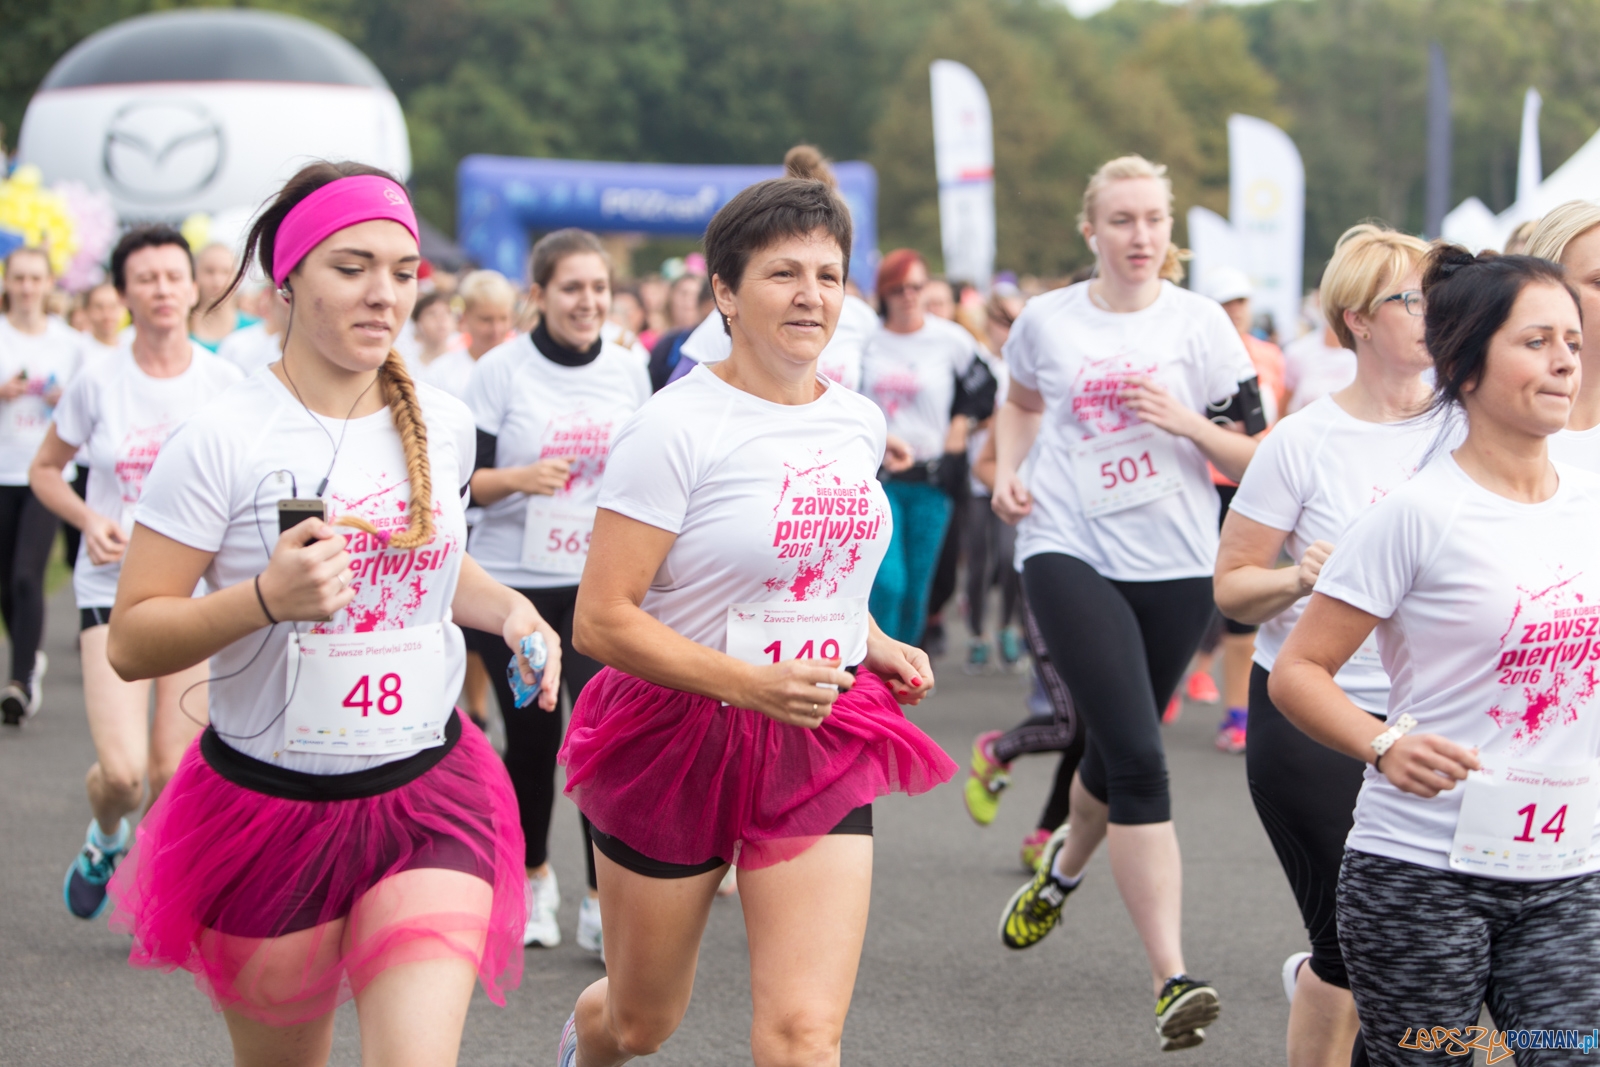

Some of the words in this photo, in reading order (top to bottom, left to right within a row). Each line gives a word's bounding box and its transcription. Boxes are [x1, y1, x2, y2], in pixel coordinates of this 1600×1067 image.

[1101, 450, 1158, 489] 501
[817, 487, 832, 496] BIEG
[833, 488, 857, 497] KOBIET
[791, 496, 869, 516] zawsze
[773, 515, 880, 547] pier(w)si!
[777, 542, 813, 558] 2016
[348, 542, 450, 585] er(w)si!
[763, 615, 795, 623] Zawsze
[797, 613, 828, 624] Pier(w)si
[829, 613, 845, 621] 2016
[1554, 609, 1571, 618] BIEG
[1520, 617, 1600, 645] zawsz
[328, 648, 363, 658] Zawsze
[365, 643, 401, 656] Pier(w)si
[403, 641, 422, 652] 2016
[1495, 638, 1600, 673] pier(w)s
[1498, 668, 1542, 684] 2016
[342, 672, 403, 717] 48
[1506, 772, 1540, 785] Zawsze
[1513, 803, 1568, 843] 14
